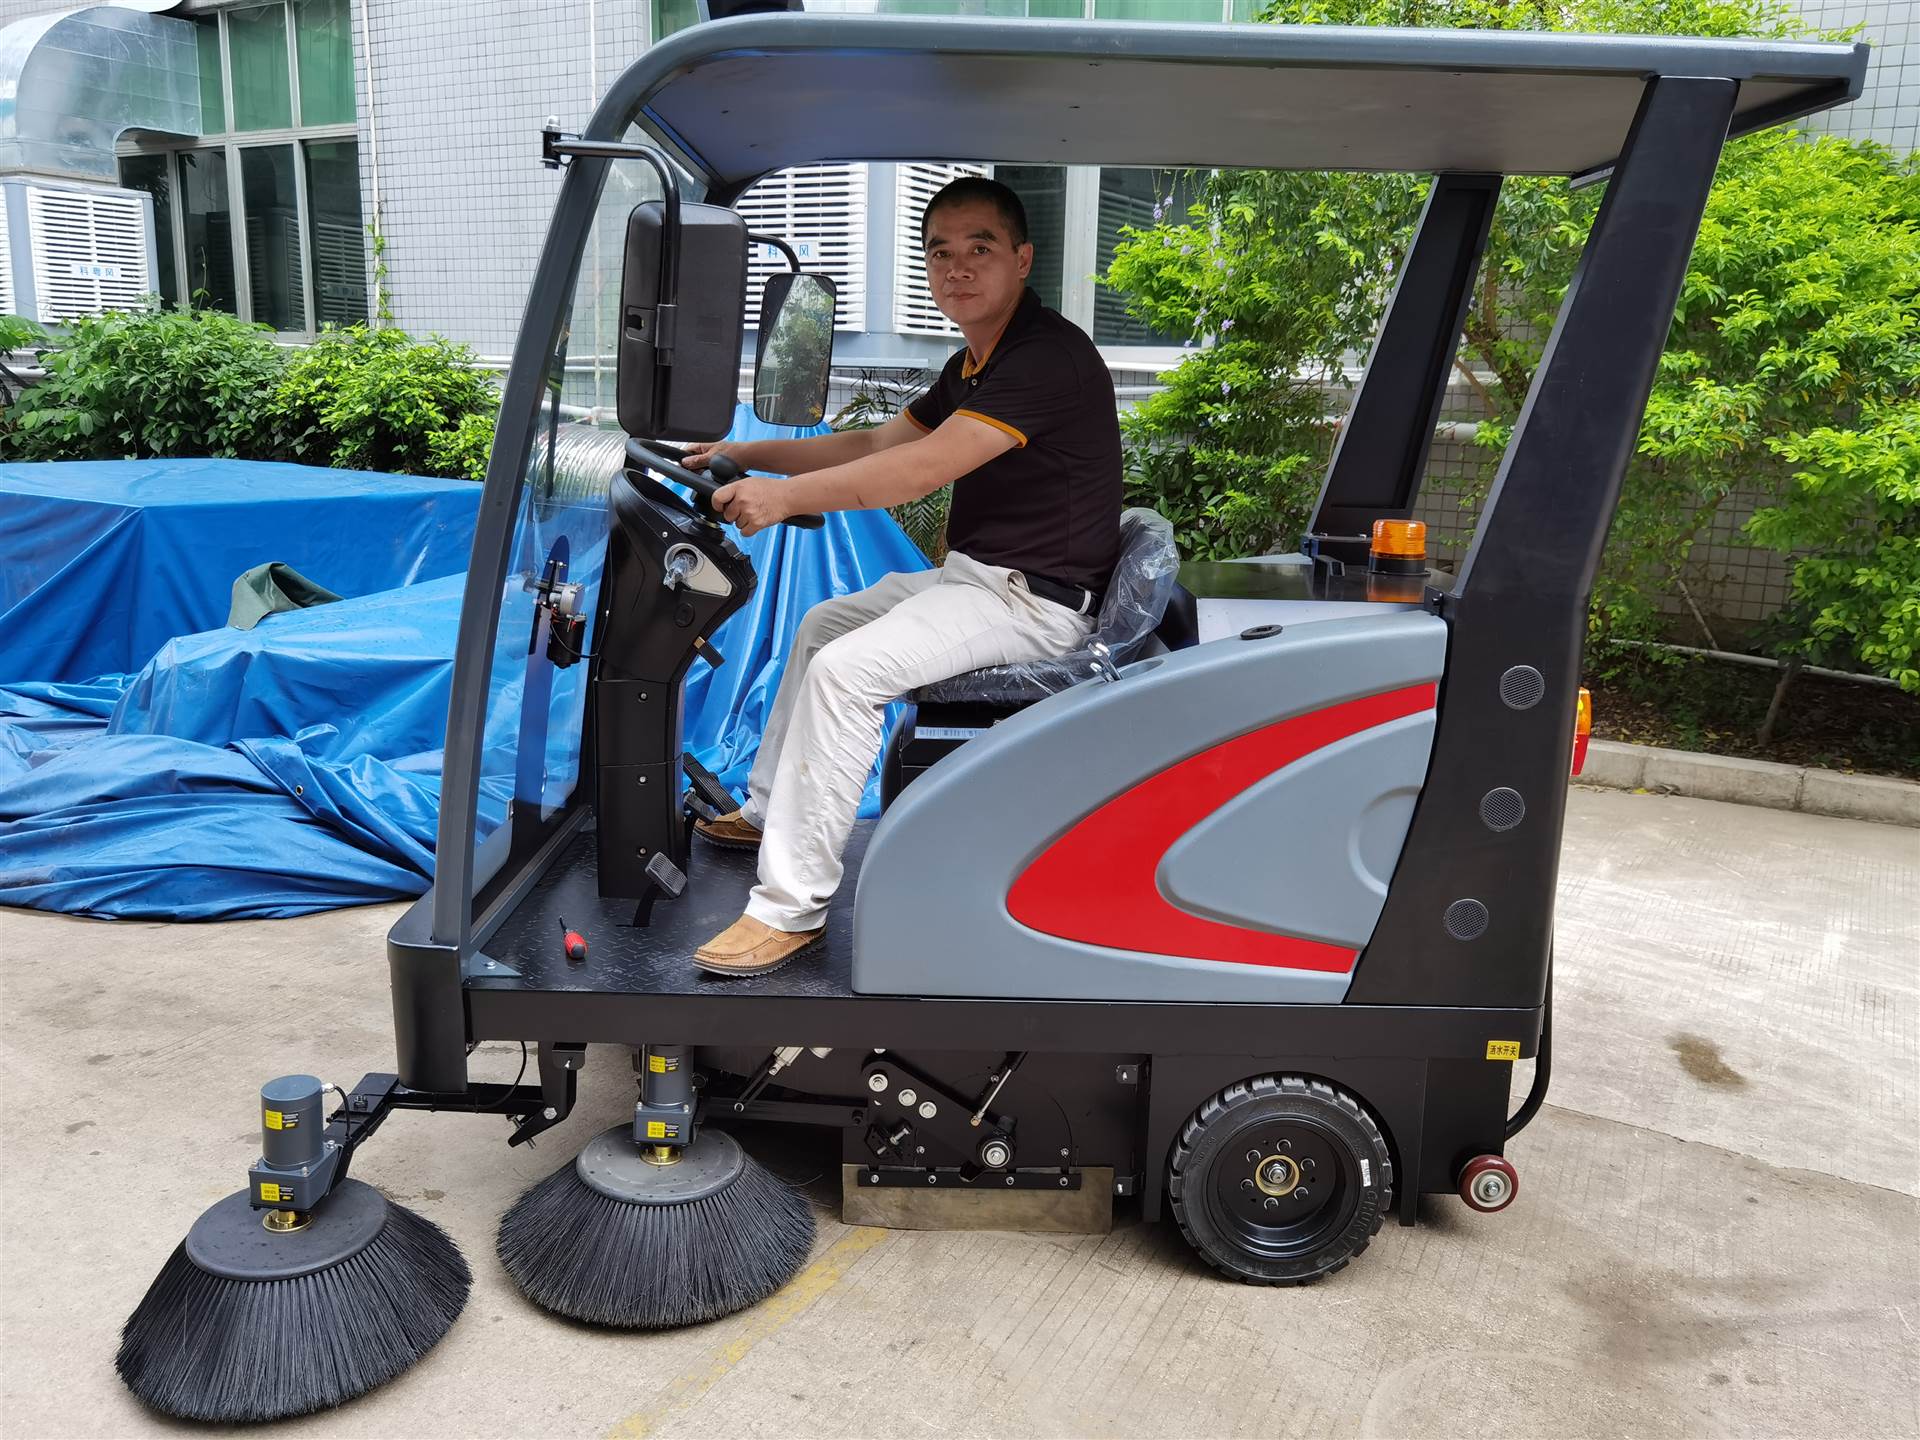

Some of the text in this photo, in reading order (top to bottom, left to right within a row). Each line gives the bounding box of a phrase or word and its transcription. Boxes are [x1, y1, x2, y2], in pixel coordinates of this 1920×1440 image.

[767, 244, 810, 258] 科风
[1489, 1045, 1517, 1056] 洒水开关
